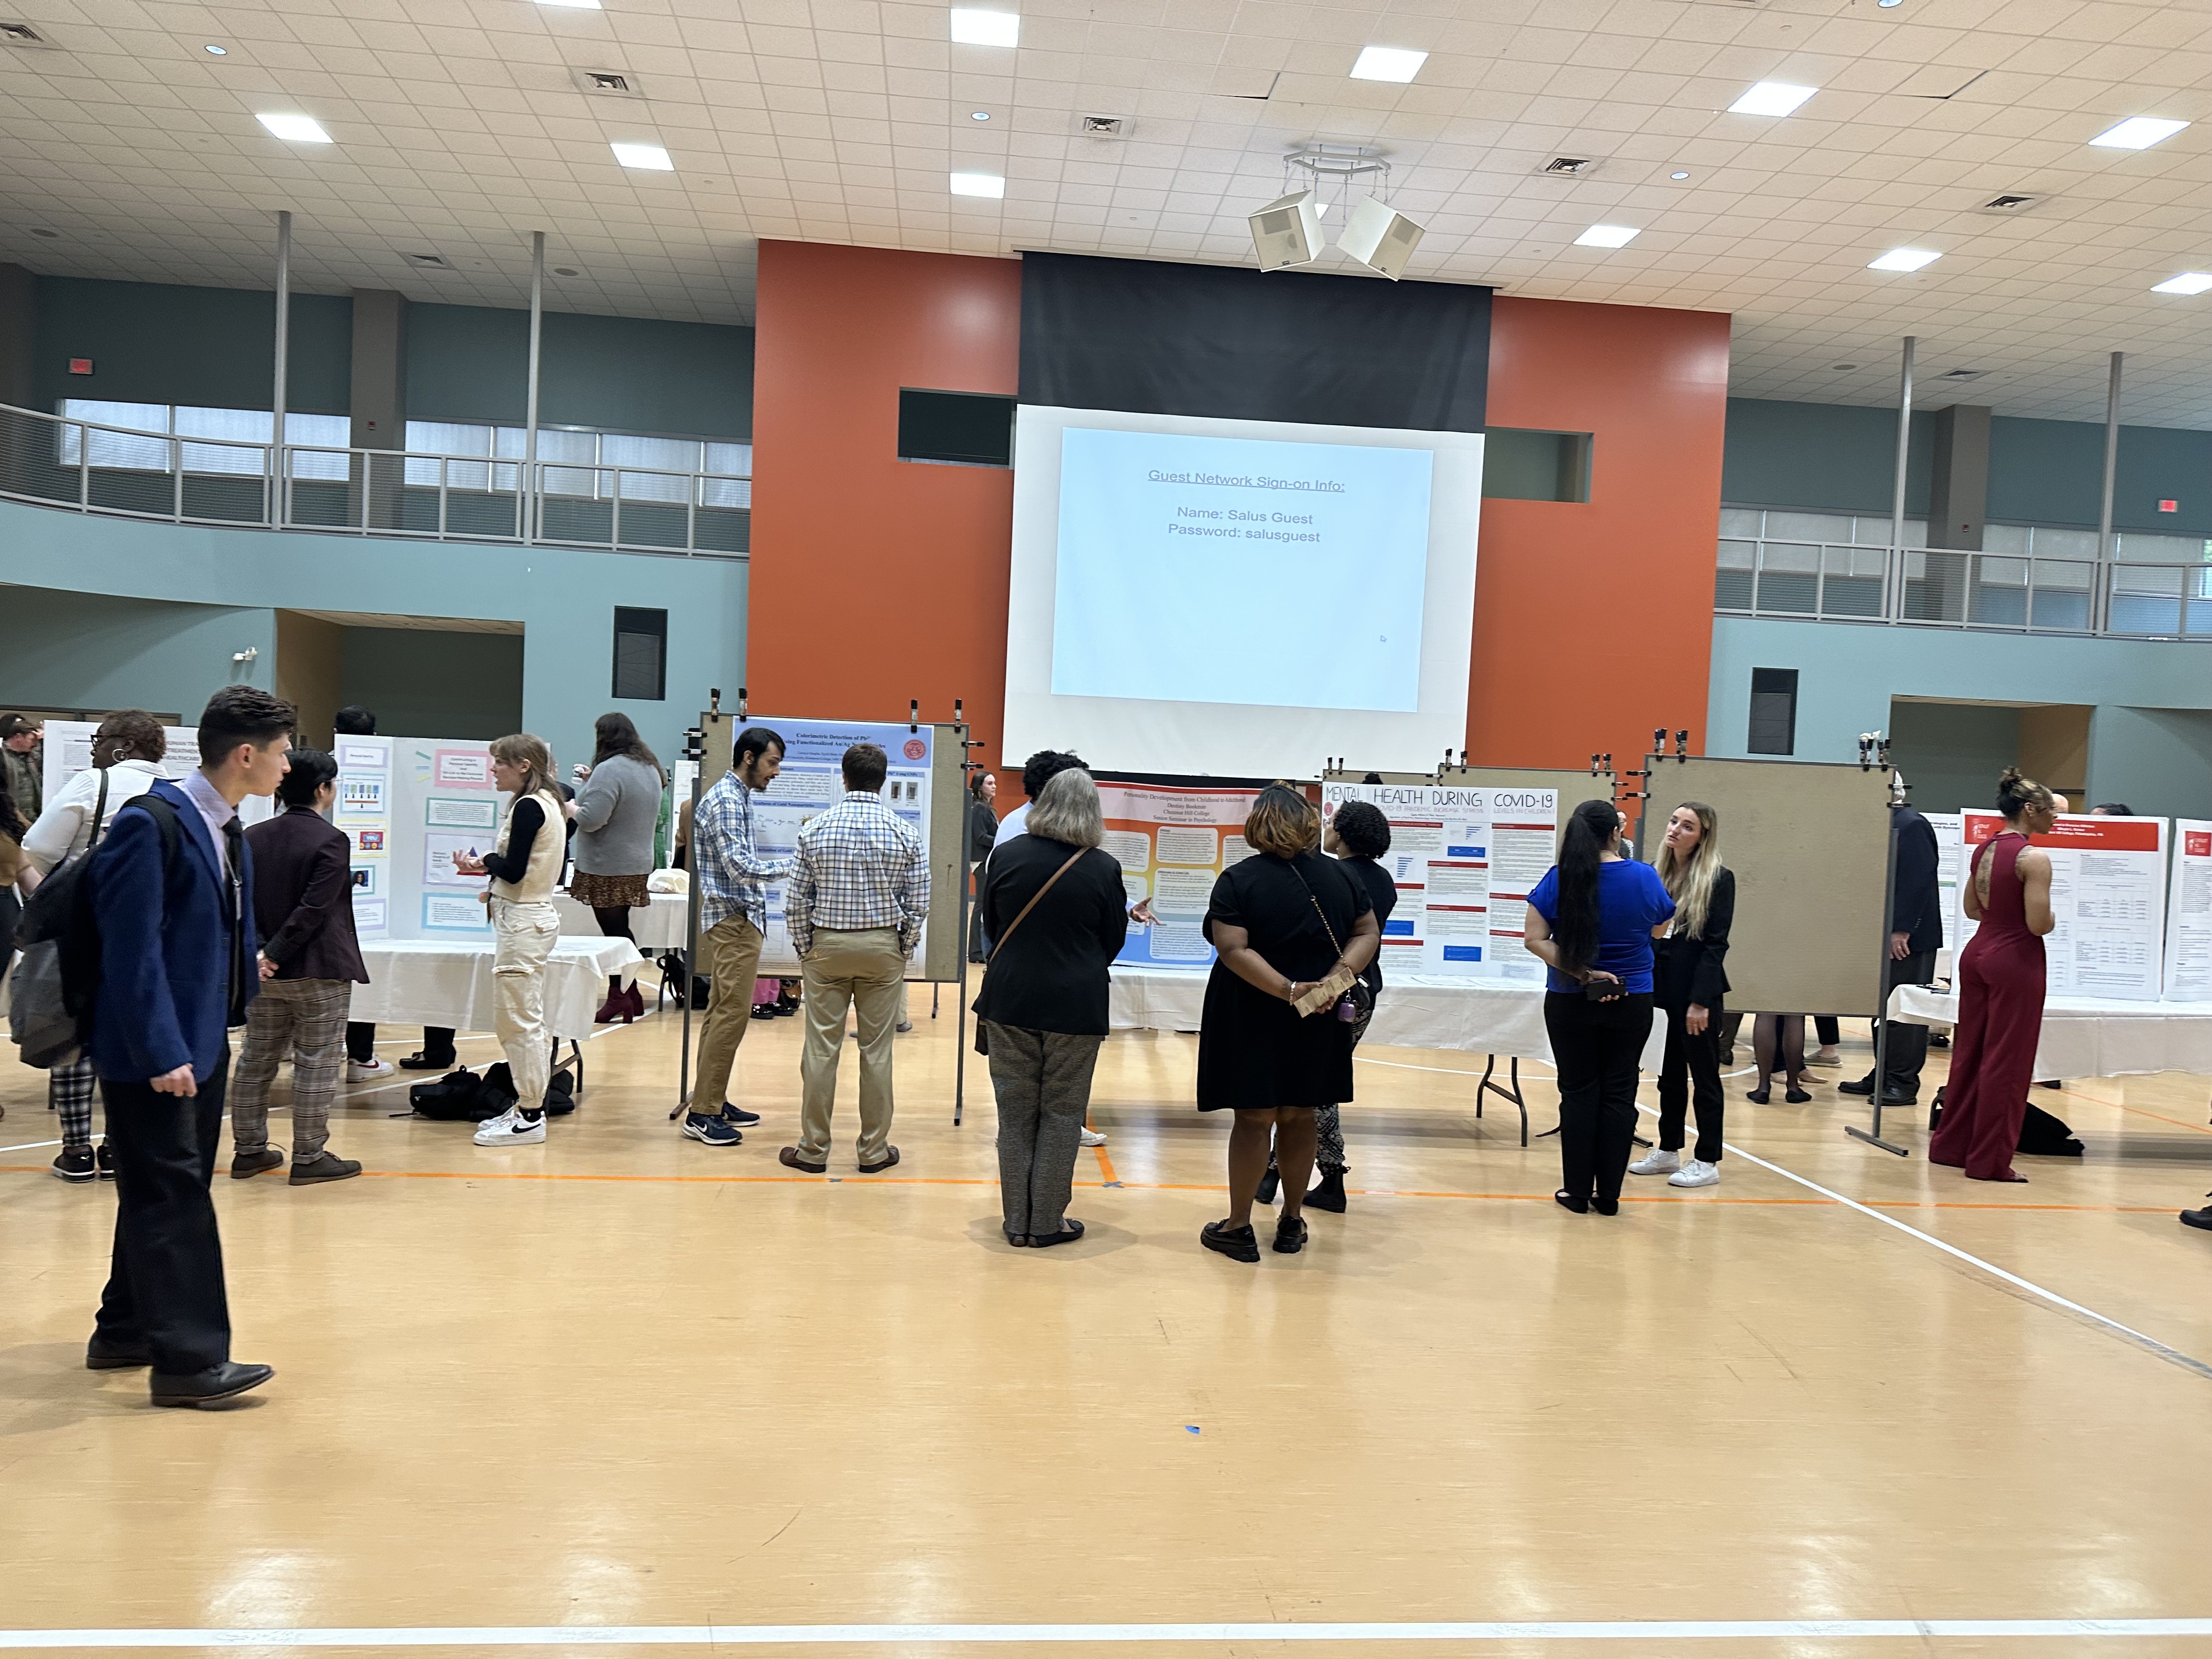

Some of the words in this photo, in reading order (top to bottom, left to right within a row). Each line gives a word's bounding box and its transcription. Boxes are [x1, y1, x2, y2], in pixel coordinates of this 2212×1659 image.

[1148, 470, 1190, 483] Guest
[1195, 472, 1252, 486] Network
[1257, 476, 1310, 490] Sign-on
[1316, 480, 1345, 492] Info:
[1177, 506, 1223, 519] Name:
[1228, 510, 1267, 522] Salus
[1271, 512, 1313, 524] Guest
[1168, 523, 1241, 538] Password:
[1245, 529, 1320, 543] salusguest
[1124, 791, 1148, 800] Personality
[1326, 786, 1363, 802] MENTAL
[1374, 788, 1423, 805] HEALTH
[1432, 791, 1482, 807] DURING
[1494, 793, 1553, 808] COVID-19
